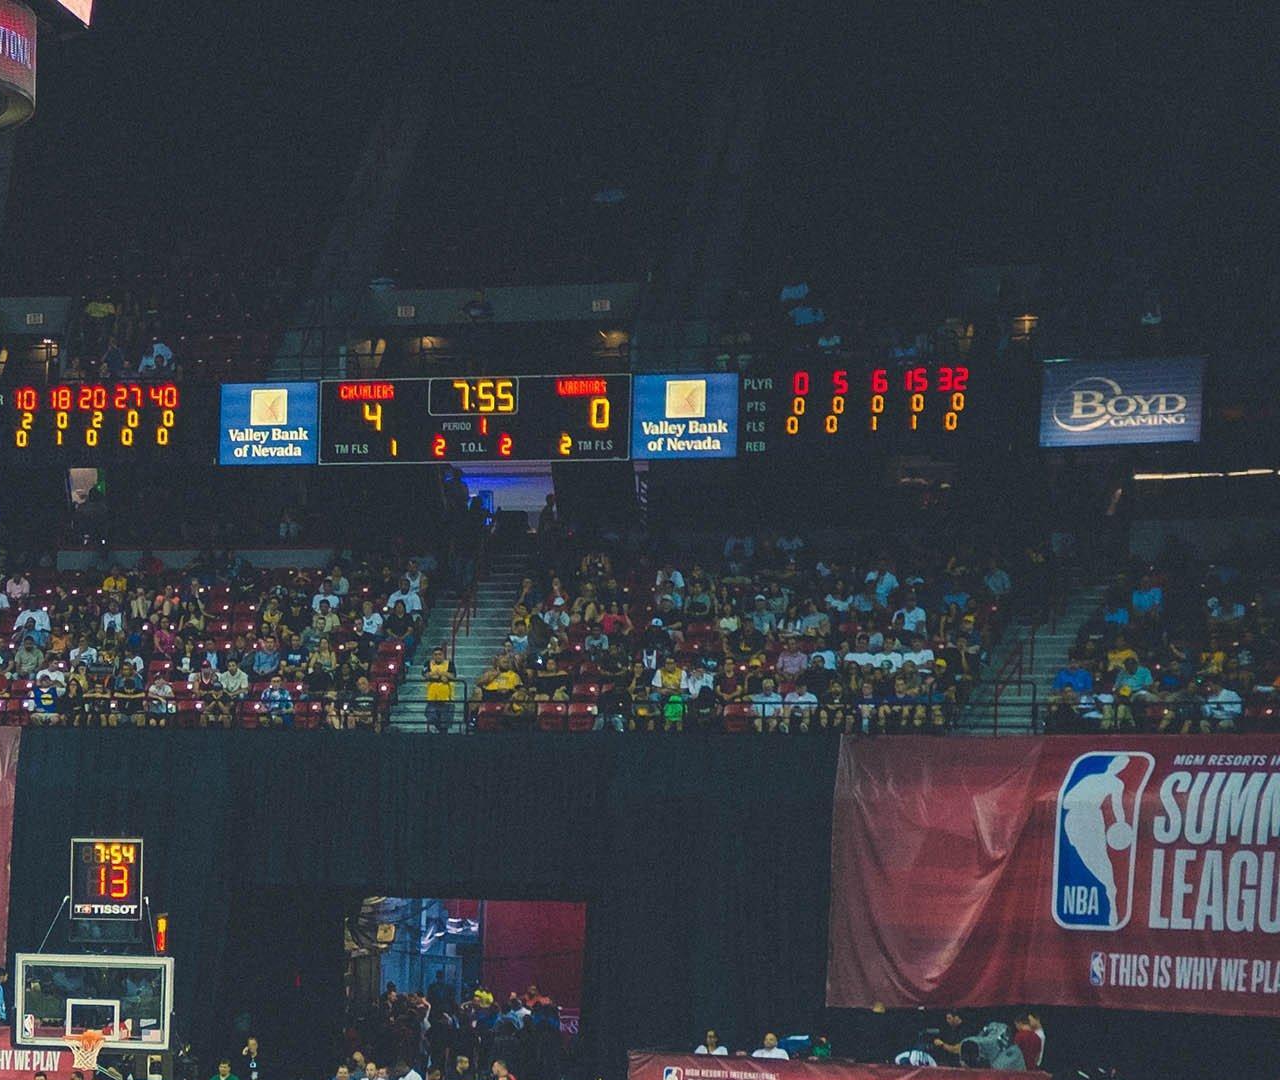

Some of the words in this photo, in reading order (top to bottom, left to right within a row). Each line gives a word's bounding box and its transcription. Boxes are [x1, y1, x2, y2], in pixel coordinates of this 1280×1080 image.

[744, 378, 772, 389] PLYR
[793, 371, 809, 396] 0
[833, 371, 848, 394] 5
[872, 369, 888, 393] 6
[904, 368, 928, 392] 15
[939, 367, 969, 391] 32
[15, 389, 36, 410] 10
[51, 386, 71, 409] 18
[79, 386, 106, 408] 20
[115, 386, 142, 408] 27
[150, 385, 178, 408] 40
[453, 380, 515, 413] 7:55
[746, 401, 766, 412] PTS
[794, 396, 805, 416] 0
[833, 395, 844, 414] 0
[872, 394, 883, 413] 0
[912, 393, 923, 412] 0
[952, 393, 964, 412] 0
[22, 411, 33, 429] 2
[57, 411, 68, 428] 0
[92, 411, 103, 428] 2
[127, 410, 139, 428] 0
[163, 410, 174, 428] 0
[363, 403, 382, 432] 4
[591, 397, 610, 429] 0
[1109, 414, 1186, 427] GAMING
[443, 421, 472, 432] PERIOD
[642, 422, 685, 436] Valley
[688, 420, 728, 433] Bank
[746, 422, 765, 432] FLS
[786, 416, 799, 434] 0
[826, 415, 838, 434] 0
[945, 412, 957, 431] 0
[16, 429, 27, 447] 0
[86, 429, 98, 446] 0
[121, 428, 133, 446] 0
[157, 428, 168, 446] 0
[229, 429, 269, 443] Valley
[271, 428, 309, 441] Bank
[559, 435, 571, 455] 2
[577, 441, 592, 451] TM
[594, 440, 613, 450] FLS
[648, 438, 664, 451] of
[666, 438, 721, 451] Nevada
[234, 444, 249, 457] of
[251, 444, 302, 457] Nevada
[335, 444, 349, 454] TM
[351, 443, 369, 454] FLS
[434, 438, 446, 456] 2
[461, 442, 487, 453] T.O.L.
[500, 437, 512, 455] 2
[746, 441, 766, 452] REB
[1173, 754, 1205, 766] MGM
[1207, 754, 1268, 766] RESORTS
[95, 844, 135, 864] 7:54
[99, 865, 129, 898] 13
[92, 904, 138, 914] TISSOT
[1063, 886, 1100, 916] NBA
[1108, 953, 1149, 988] THIS
[1152, 955, 1172, 988] IS
[1175, 956, 1217, 990] WHY
[1220, 957, 1248, 992] WE
[14, 1051, 31, 1070] WE
[32, 1051, 60, 1072] PLAY
